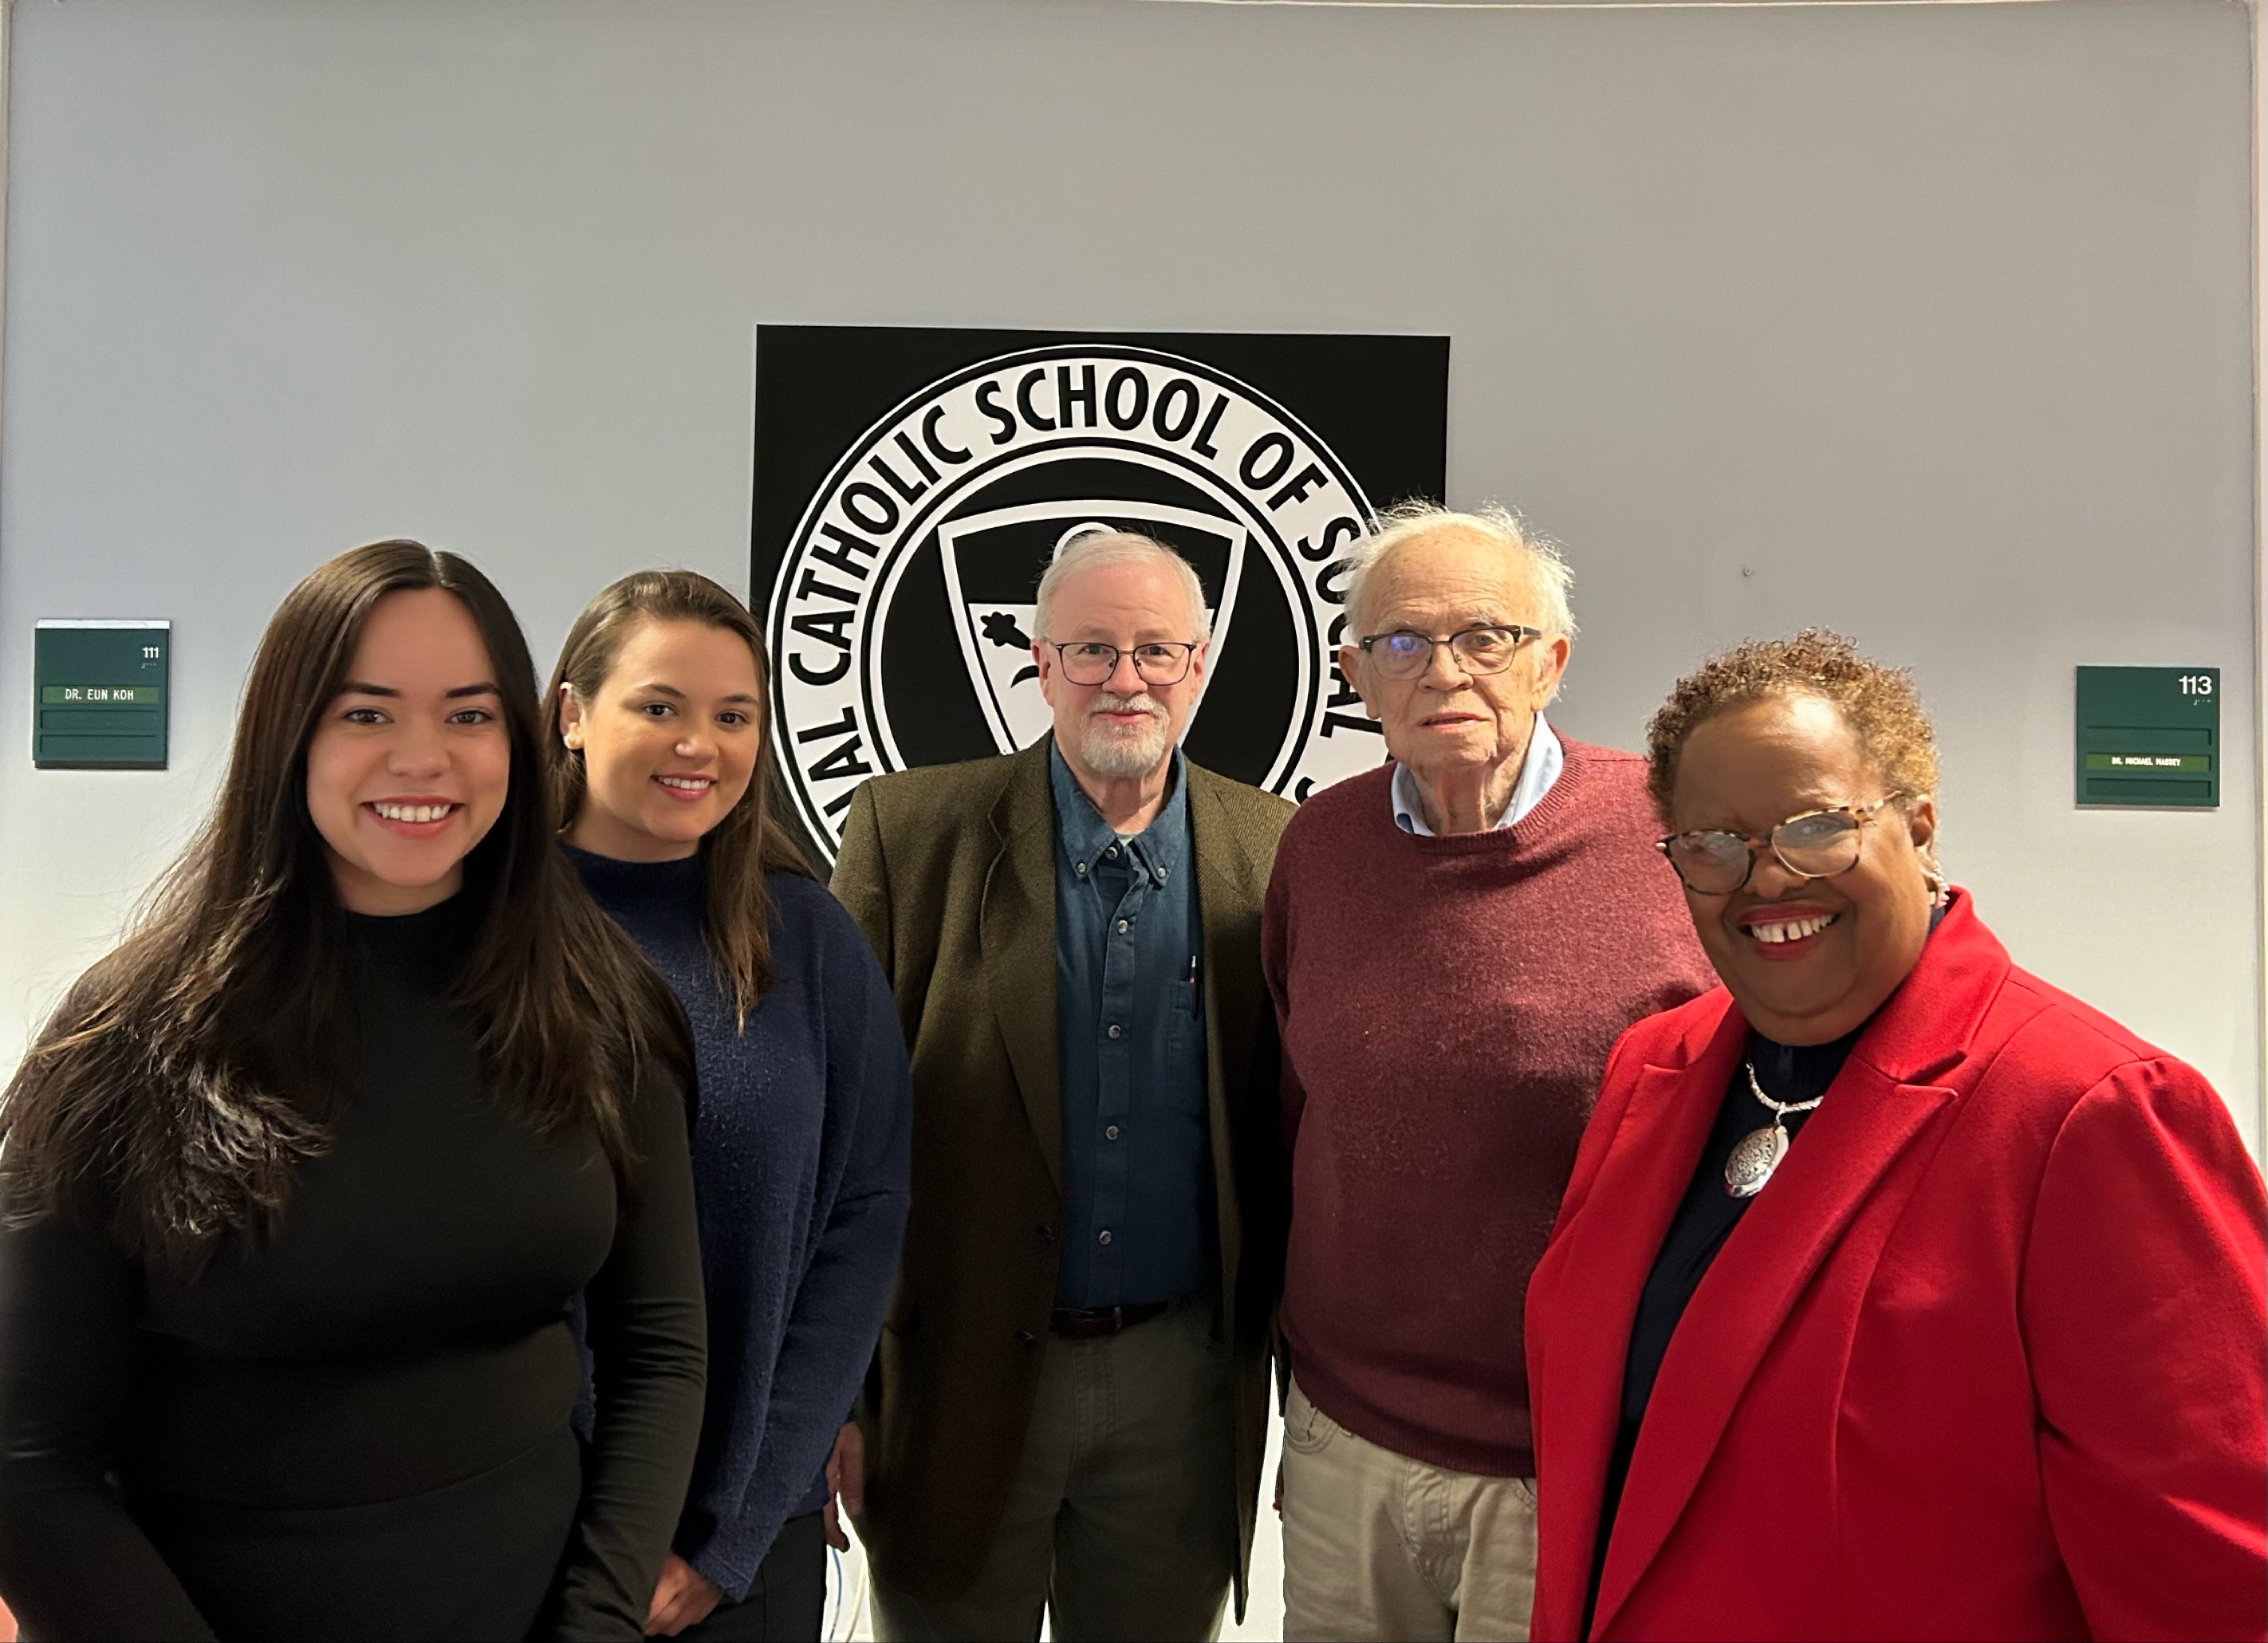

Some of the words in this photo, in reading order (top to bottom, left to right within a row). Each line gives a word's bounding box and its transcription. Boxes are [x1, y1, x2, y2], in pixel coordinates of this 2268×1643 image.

[788, 405, 973, 685] CATHOLIC
[975, 364, 1230, 460] SCHOOL
[1239, 432, 1329, 511] OF
[1298, 516, 1383, 738] SOAL
[142, 647, 159, 658] 111
[2178, 676, 2212, 694] 113
[64, 688, 82, 700] DR.
[87, 688, 108, 700] EUN
[113, 689, 134, 700] KOH
[2125, 757, 2153, 766] MICHAEL
[2156, 757, 2181, 767] MASSEY
